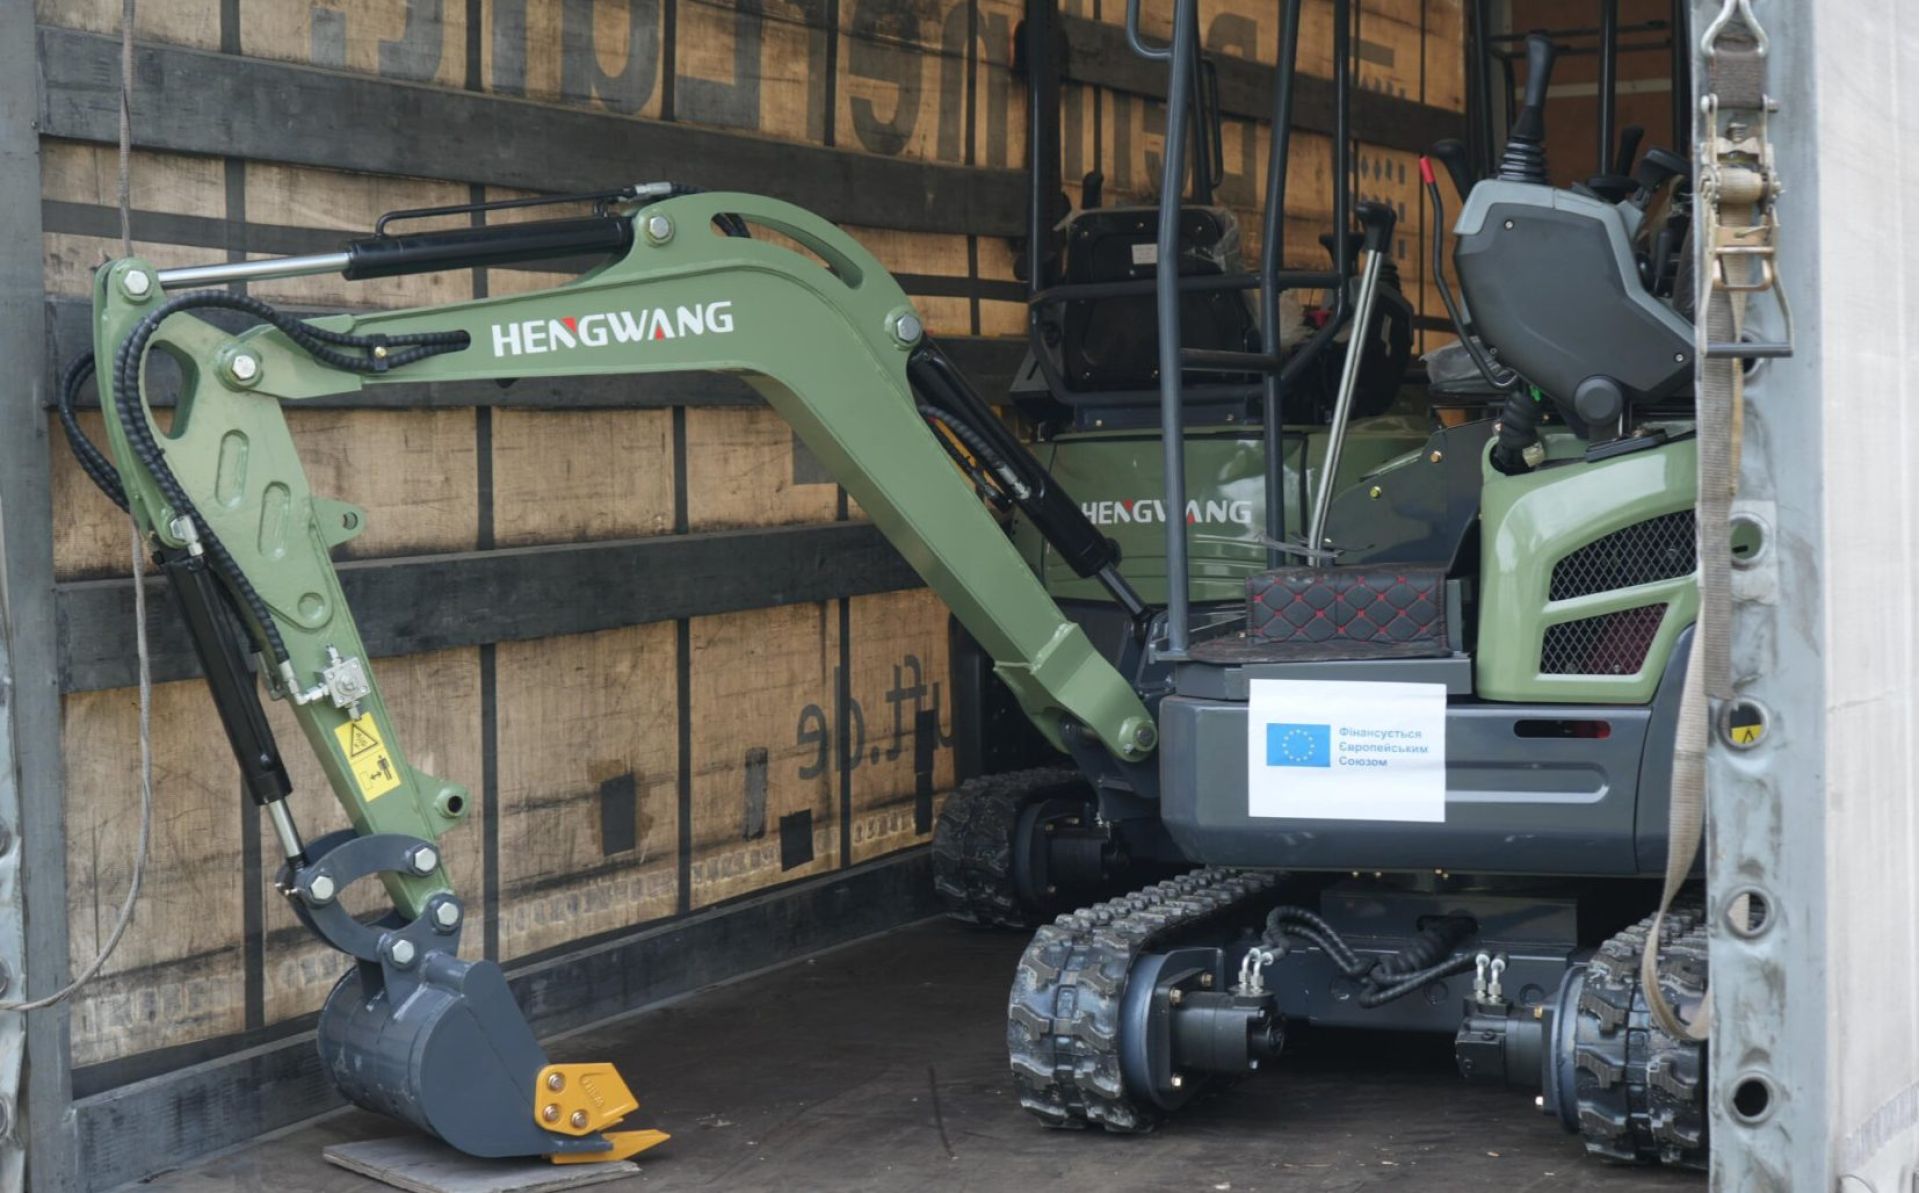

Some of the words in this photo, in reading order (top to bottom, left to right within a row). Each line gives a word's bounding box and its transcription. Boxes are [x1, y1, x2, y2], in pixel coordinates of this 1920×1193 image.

[491, 301, 734, 357] HENGWANG
[1339, 728, 1422, 740] Фінансується
[1339, 742, 1429, 753] Європейським
[1339, 756, 1388, 767] Союзом
